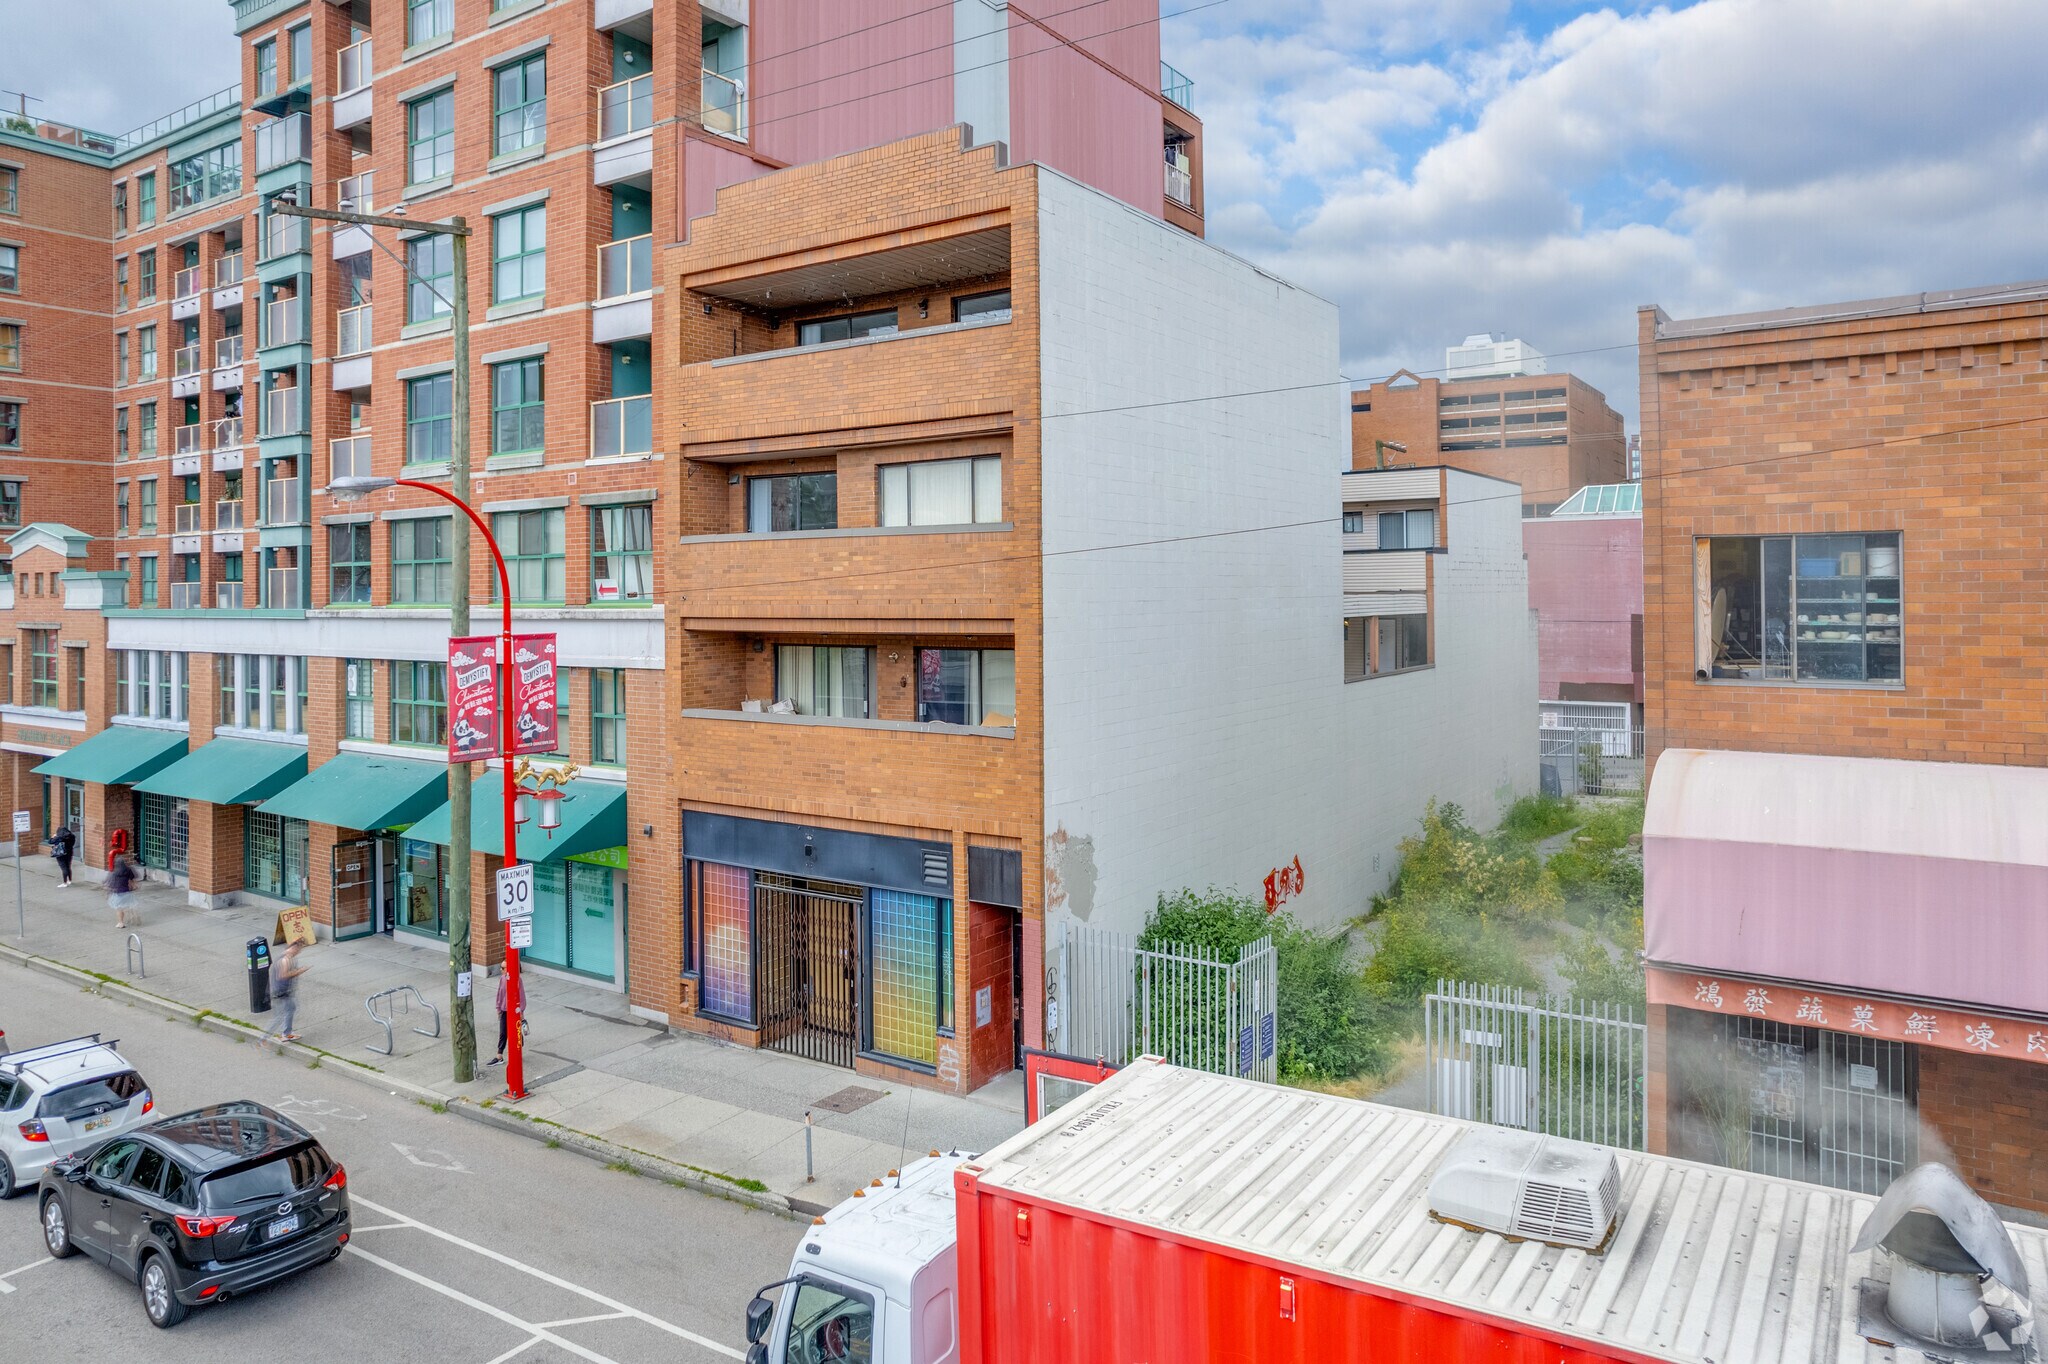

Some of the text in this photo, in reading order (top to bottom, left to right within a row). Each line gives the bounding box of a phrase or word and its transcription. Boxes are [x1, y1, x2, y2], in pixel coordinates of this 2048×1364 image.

[459, 667, 489, 688] DEMYSTIFY
[523, 663, 549, 682] DEMYSTIFY
[455, 685, 494, 706] Chinatown
[519, 679, 555, 700] Chinatown
[347, 863, 360, 871] OPEN
[500, 869, 530, 881] MAXIMUM
[503, 880, 528, 905] 30
[282, 909, 307, 922] OPEN
[507, 906, 525, 914] km/h
